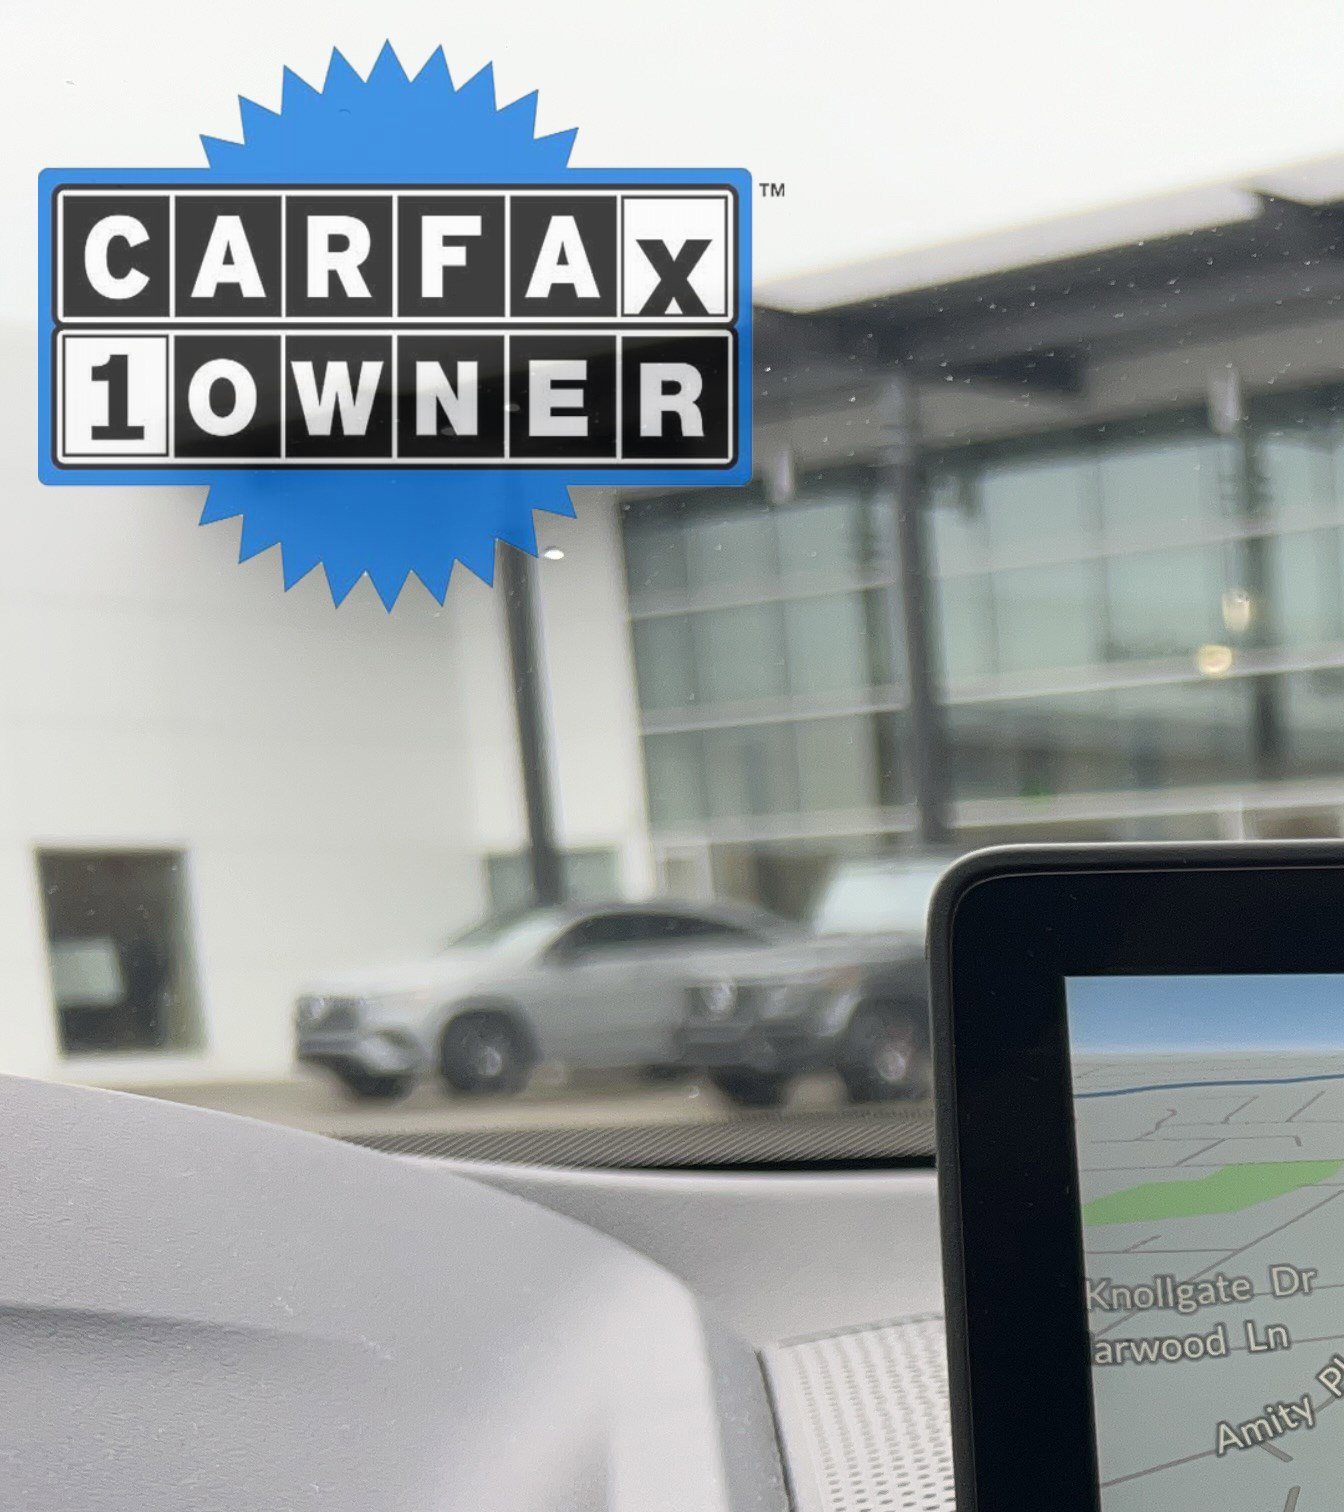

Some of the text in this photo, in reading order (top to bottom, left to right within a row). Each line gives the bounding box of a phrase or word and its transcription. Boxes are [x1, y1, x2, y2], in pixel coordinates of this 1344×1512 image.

[1085, 1265, 1317, 1314] Knollgate Dr
[1246, 1321, 1289, 1351] Ln
[1216, 1396, 1314, 1455] Amity
